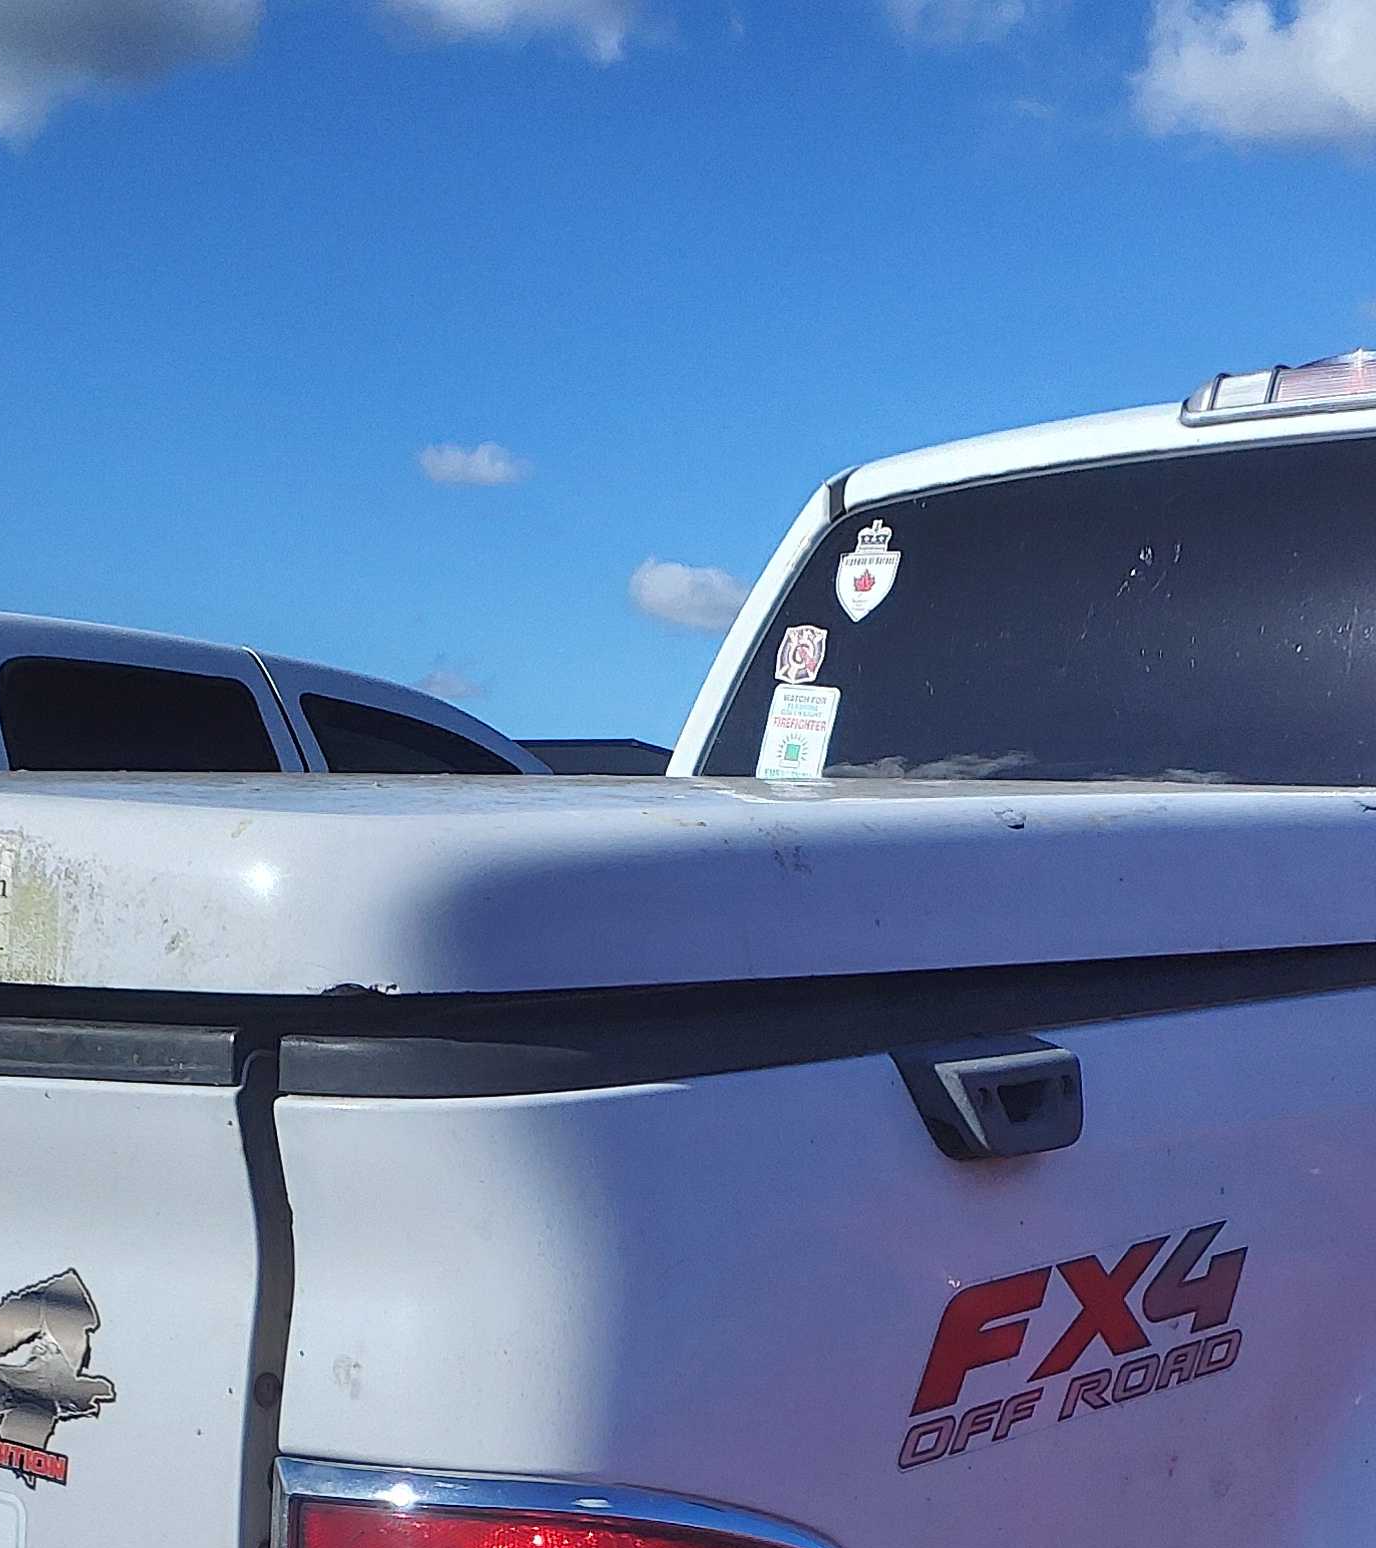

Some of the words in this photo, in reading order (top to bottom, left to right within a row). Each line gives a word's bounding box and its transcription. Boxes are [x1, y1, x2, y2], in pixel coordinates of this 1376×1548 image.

[773, 716, 827, 732] FIREFIGHTER
[908, 1219, 1249, 1418] FX4
[897, 1387, 1045, 1470] OFF
[1057, 1328, 1243, 1422] ROAD
